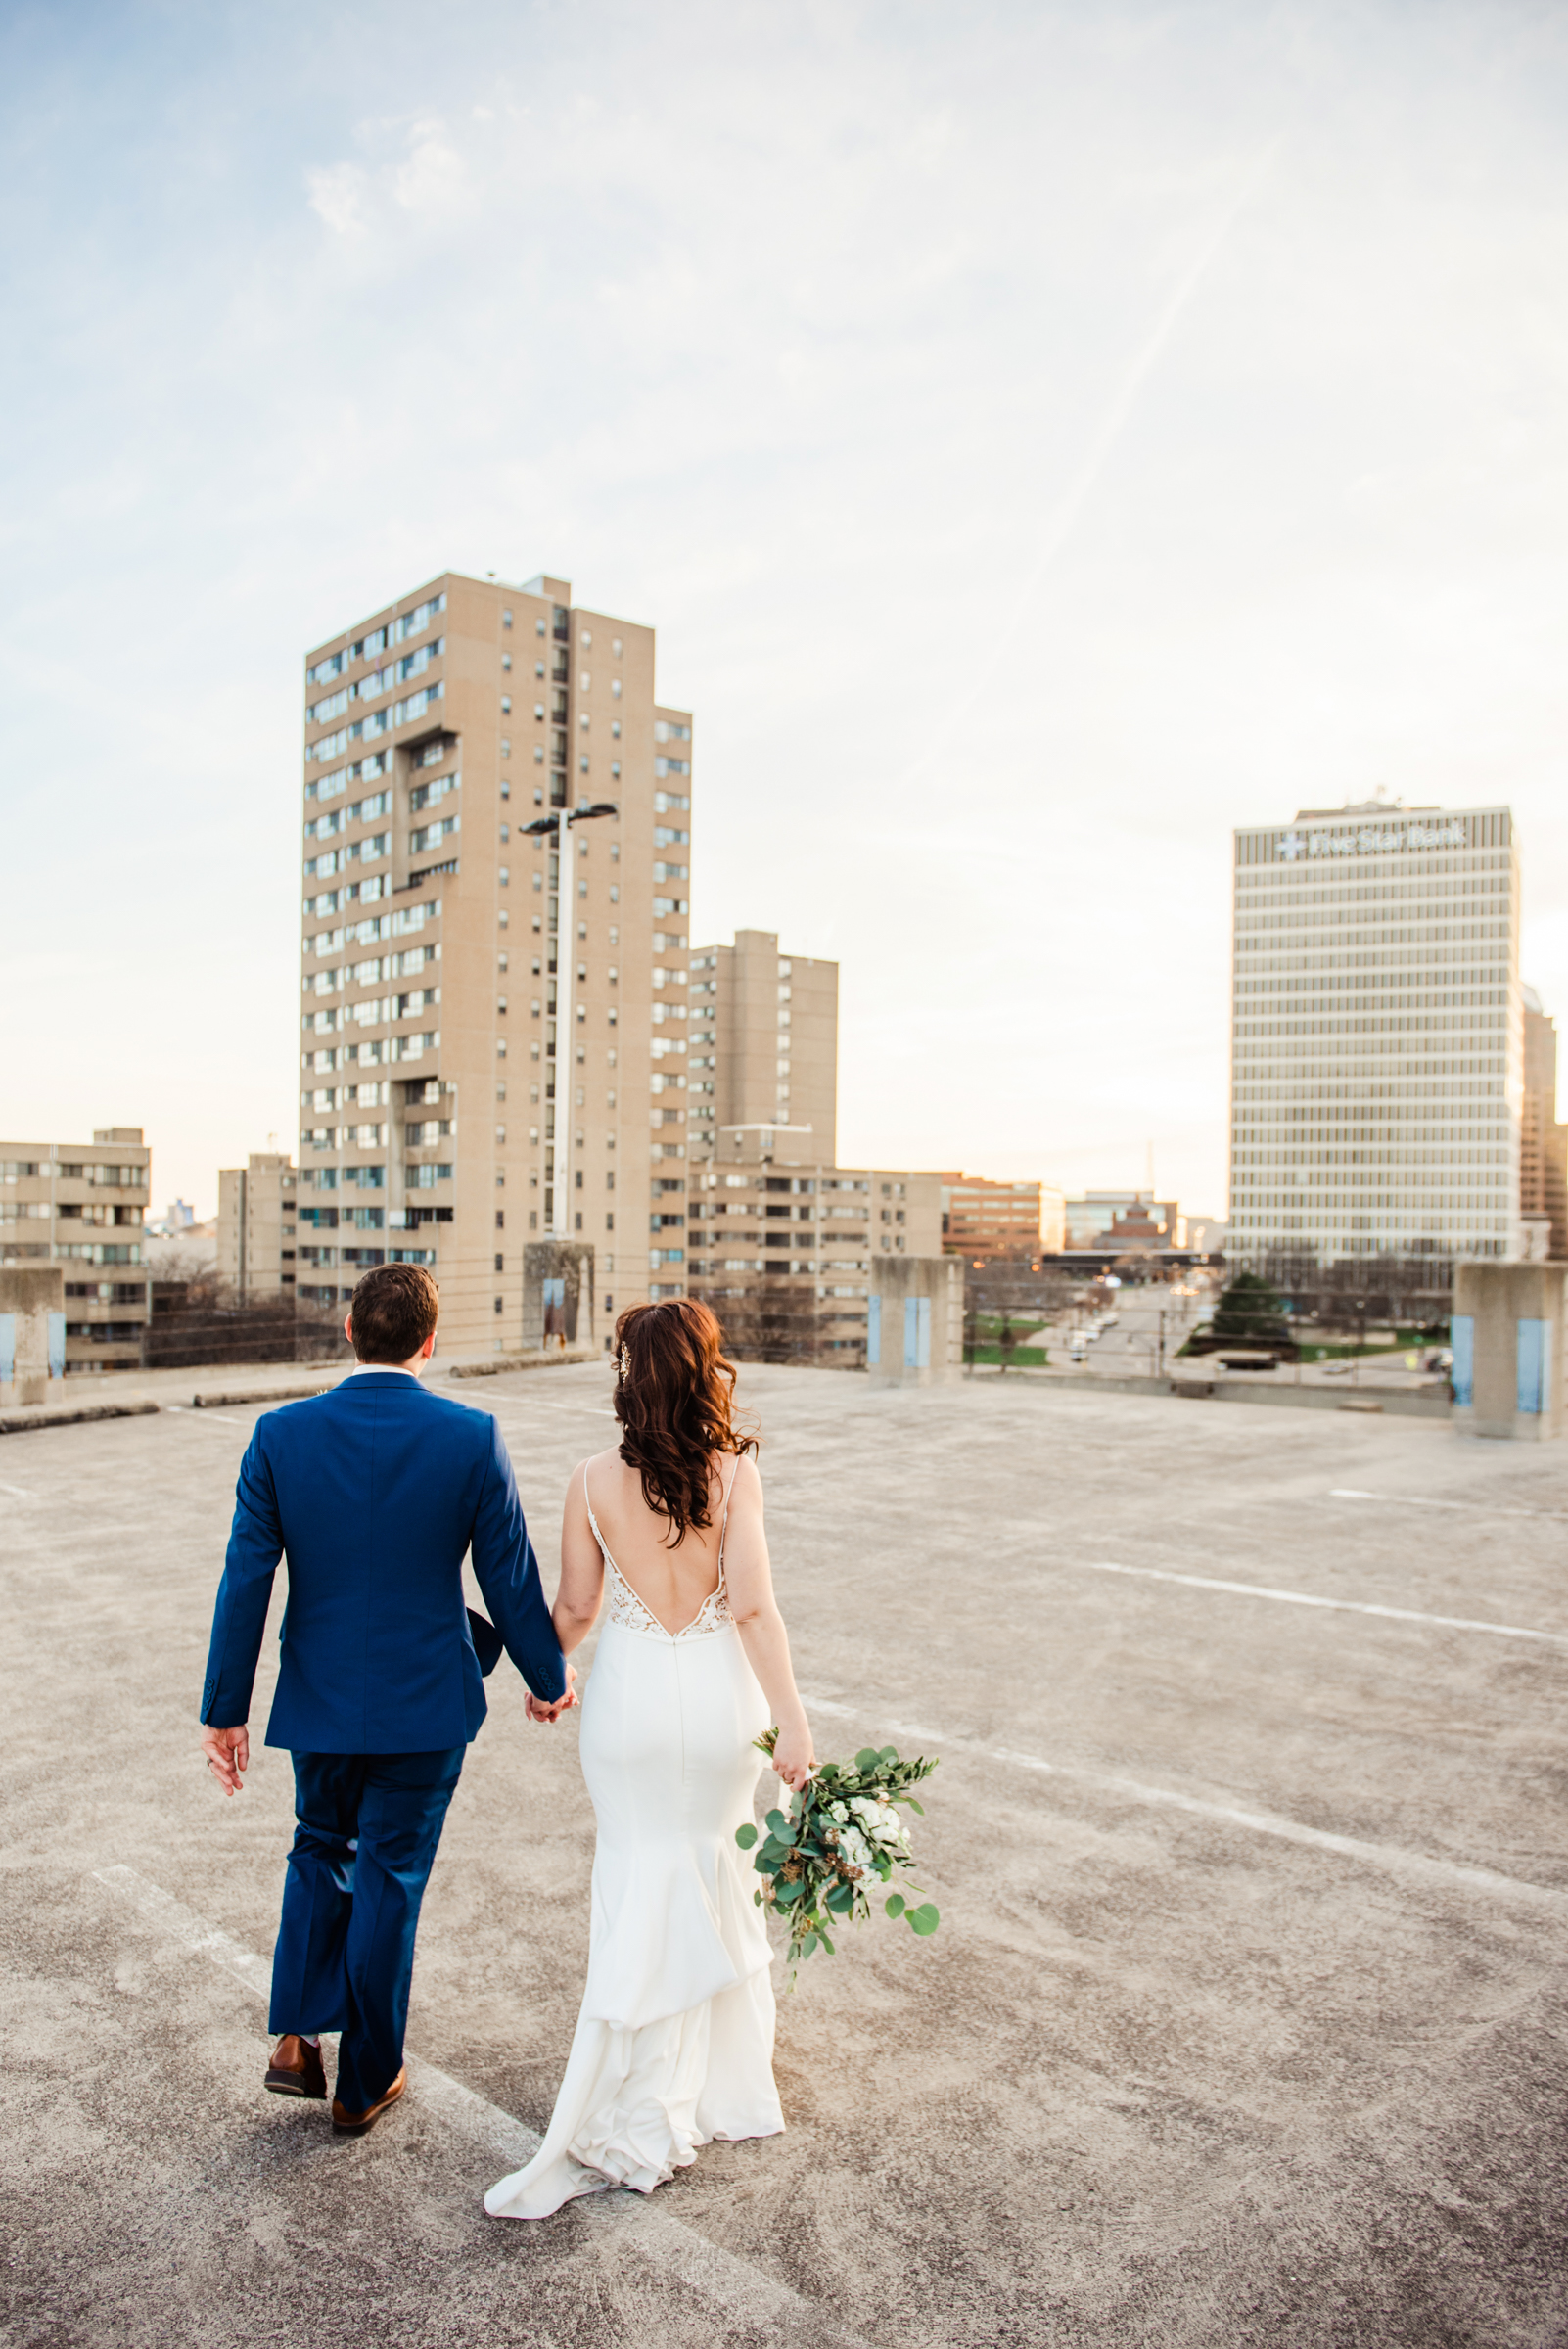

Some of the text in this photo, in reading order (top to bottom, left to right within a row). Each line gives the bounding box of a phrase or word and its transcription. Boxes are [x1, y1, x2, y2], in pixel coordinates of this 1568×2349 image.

[1308, 822, 1466, 855] Five Star Bank
